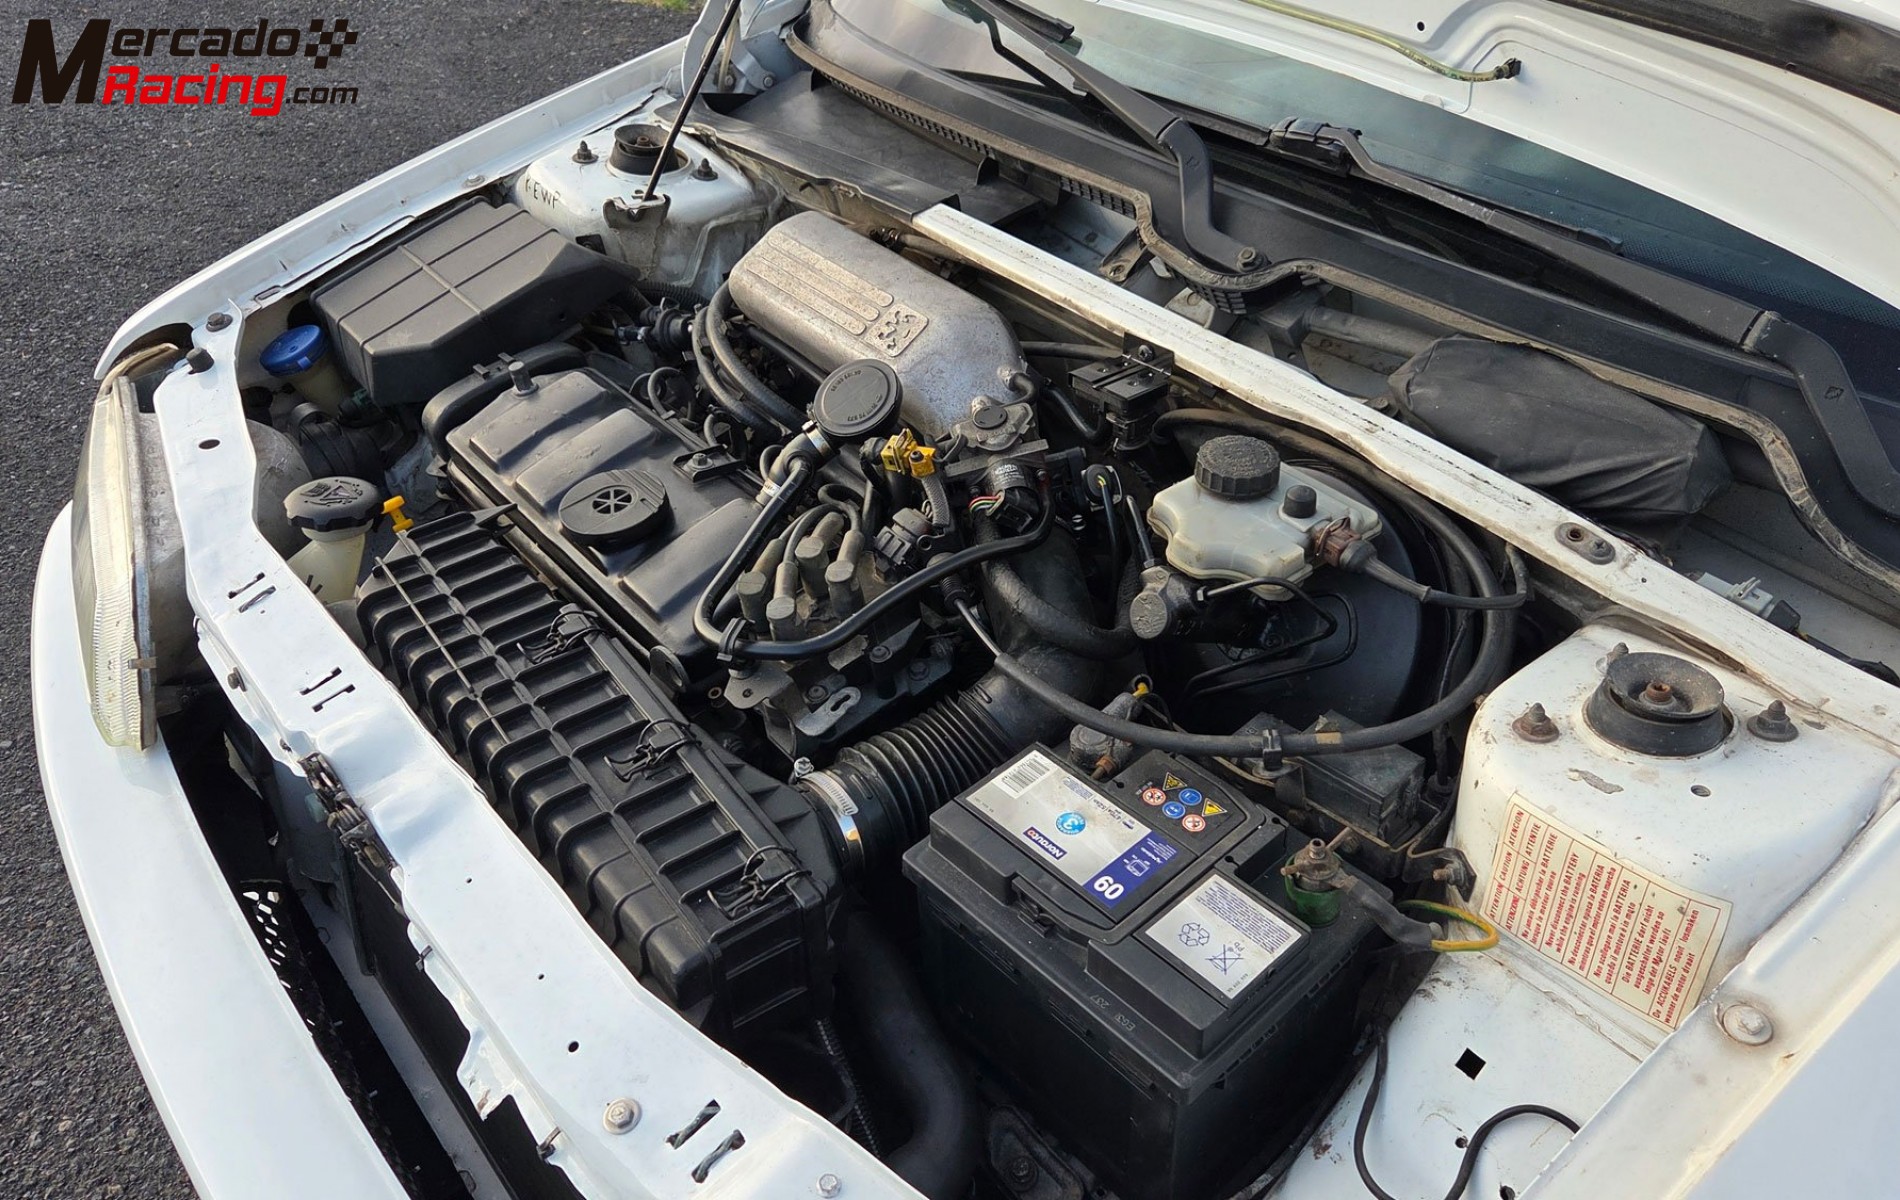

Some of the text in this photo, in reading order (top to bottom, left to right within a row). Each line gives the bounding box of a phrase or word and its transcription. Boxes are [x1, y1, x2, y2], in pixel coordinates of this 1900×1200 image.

[1062, 818, 1079, 831] 3
[1508, 810, 1524, 846] ATENCION
[1525, 823, 1541, 856] ATTENTIE
[1027, 830, 1063, 858] Norauto
[1540, 833, 1557, 868] BATTERIE
[1499, 851, 1512, 880] CAUTION
[1515, 860, 1529, 893] ACHTUNG
[1489, 882, 1504, 919] ATTENTION
[1539, 892, 1550, 915] moteur
[1545, 871, 1556, 891] tourne
[1545, 852, 1579, 946] Never disconnect the BATTERY
[1571, 920, 1587, 957] desconectar
[1589, 864, 1604, 894] BATERIA
[1586, 935, 1594, 946] que
[1592, 910, 1601, 929] motor
[1604, 867, 1616, 890] marcha
[1555, 936, 1564, 953] while
[1560, 925, 1568, 936] the
[1564, 904, 1574, 924] engine
[1572, 872, 1586, 898] running
[1593, 965, 1602, 977] Non
[1599, 934, 1612, 965] scollegare
[1608, 922, 1616, 934] mai
[1612, 879, 1630, 914] BATTERIA
[1233, 941, 1245, 951] Pb
[1605, 961, 1616, 984] quando
[1613, 932, 1625, 955] motore
[1625, 902, 1636, 920] moto
[1621, 904, 1654, 983] Die BATTERIE darf nicht
[1634, 944, 1653, 988] ausgeschaltet
[1648, 920, 1661, 944] werden
[1652, 945, 1664, 966] Motor
[1656, 964, 1677, 1007] ACCUKABELS
[1680, 909, 1699, 942] losmaken
[1642, 977, 1655, 994] lange
[1648, 966, 1658, 977] der
[1675, 973, 1687, 993] motor
[1681, 952, 1695, 973] draait
